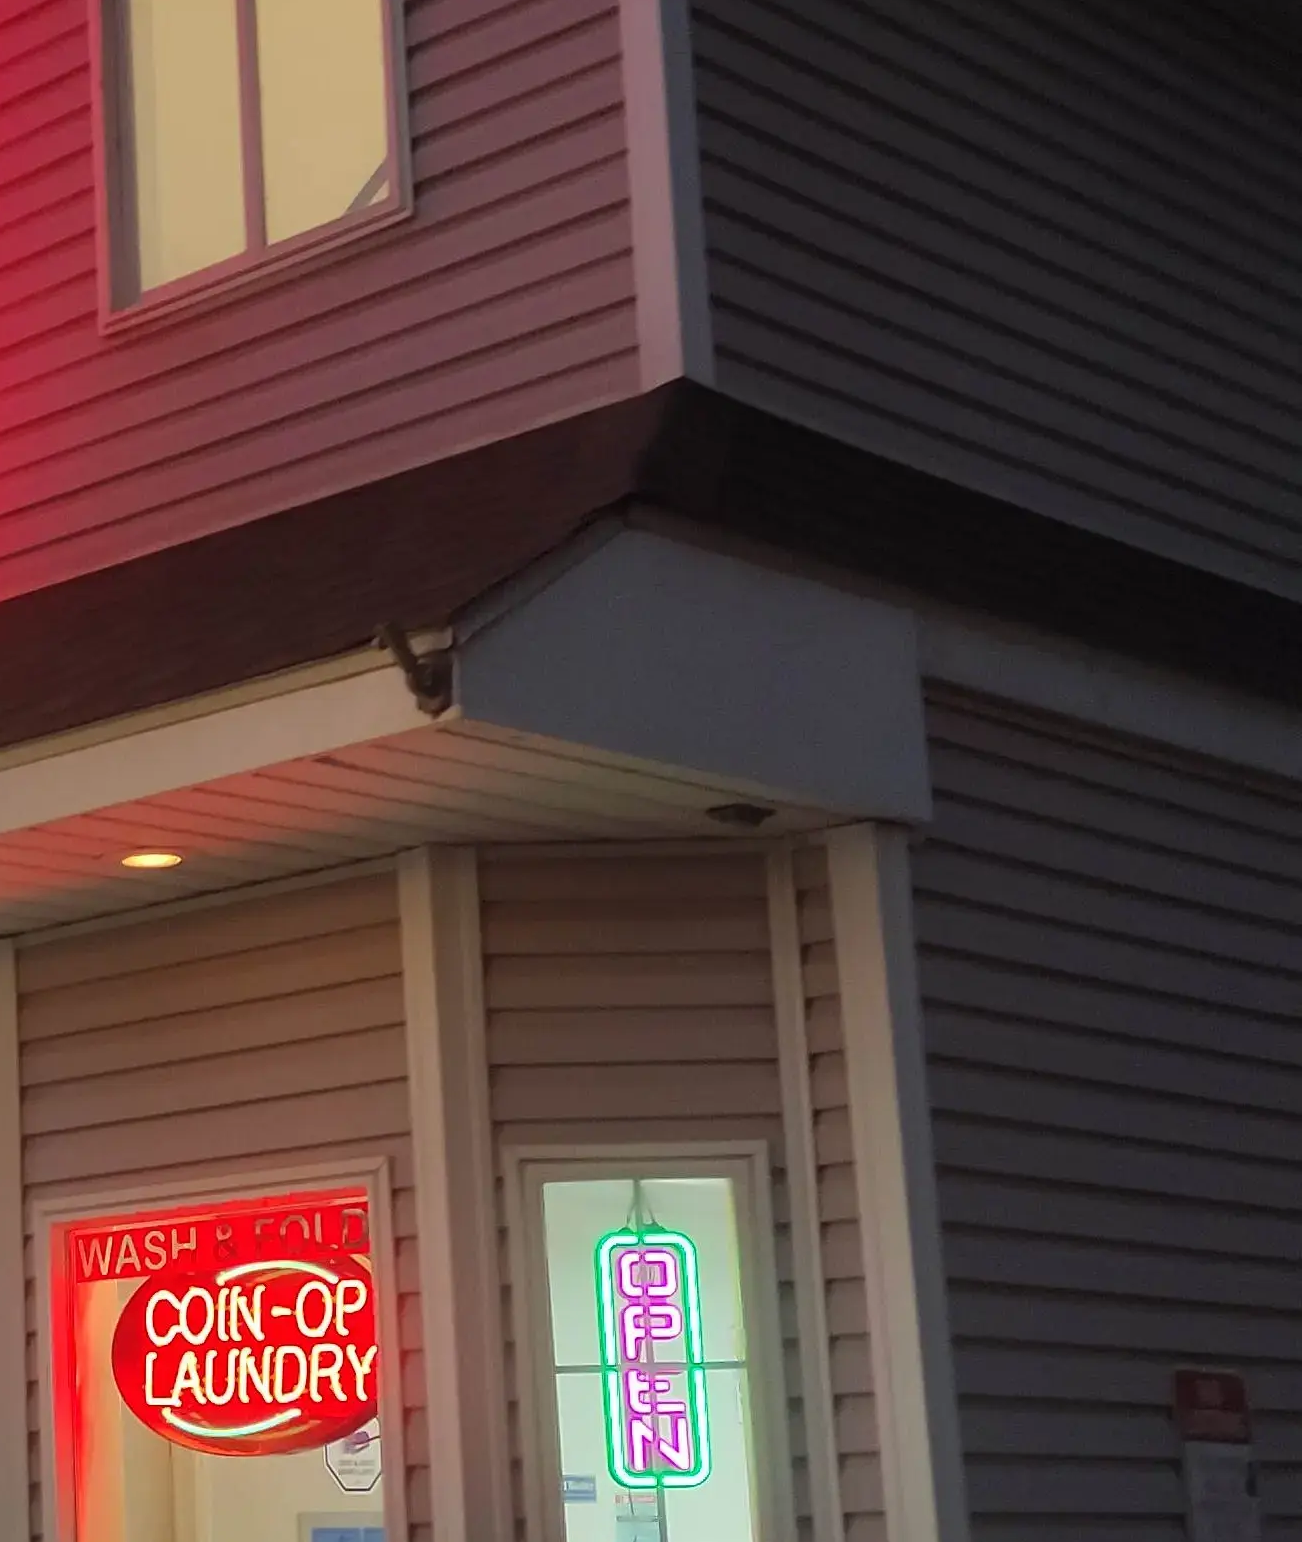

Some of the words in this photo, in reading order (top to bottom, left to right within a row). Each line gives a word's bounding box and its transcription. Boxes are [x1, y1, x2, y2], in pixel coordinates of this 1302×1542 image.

[78, 1226, 196, 1278] WASH
[213, 1223, 240, 1258] &
[254, 1209, 369, 1257] FOLD
[145, 1279, 368, 1346] COIN-OP
[144, 1343, 378, 1407] LAUNDRY
[619, 1250, 691, 1471] OPEN
